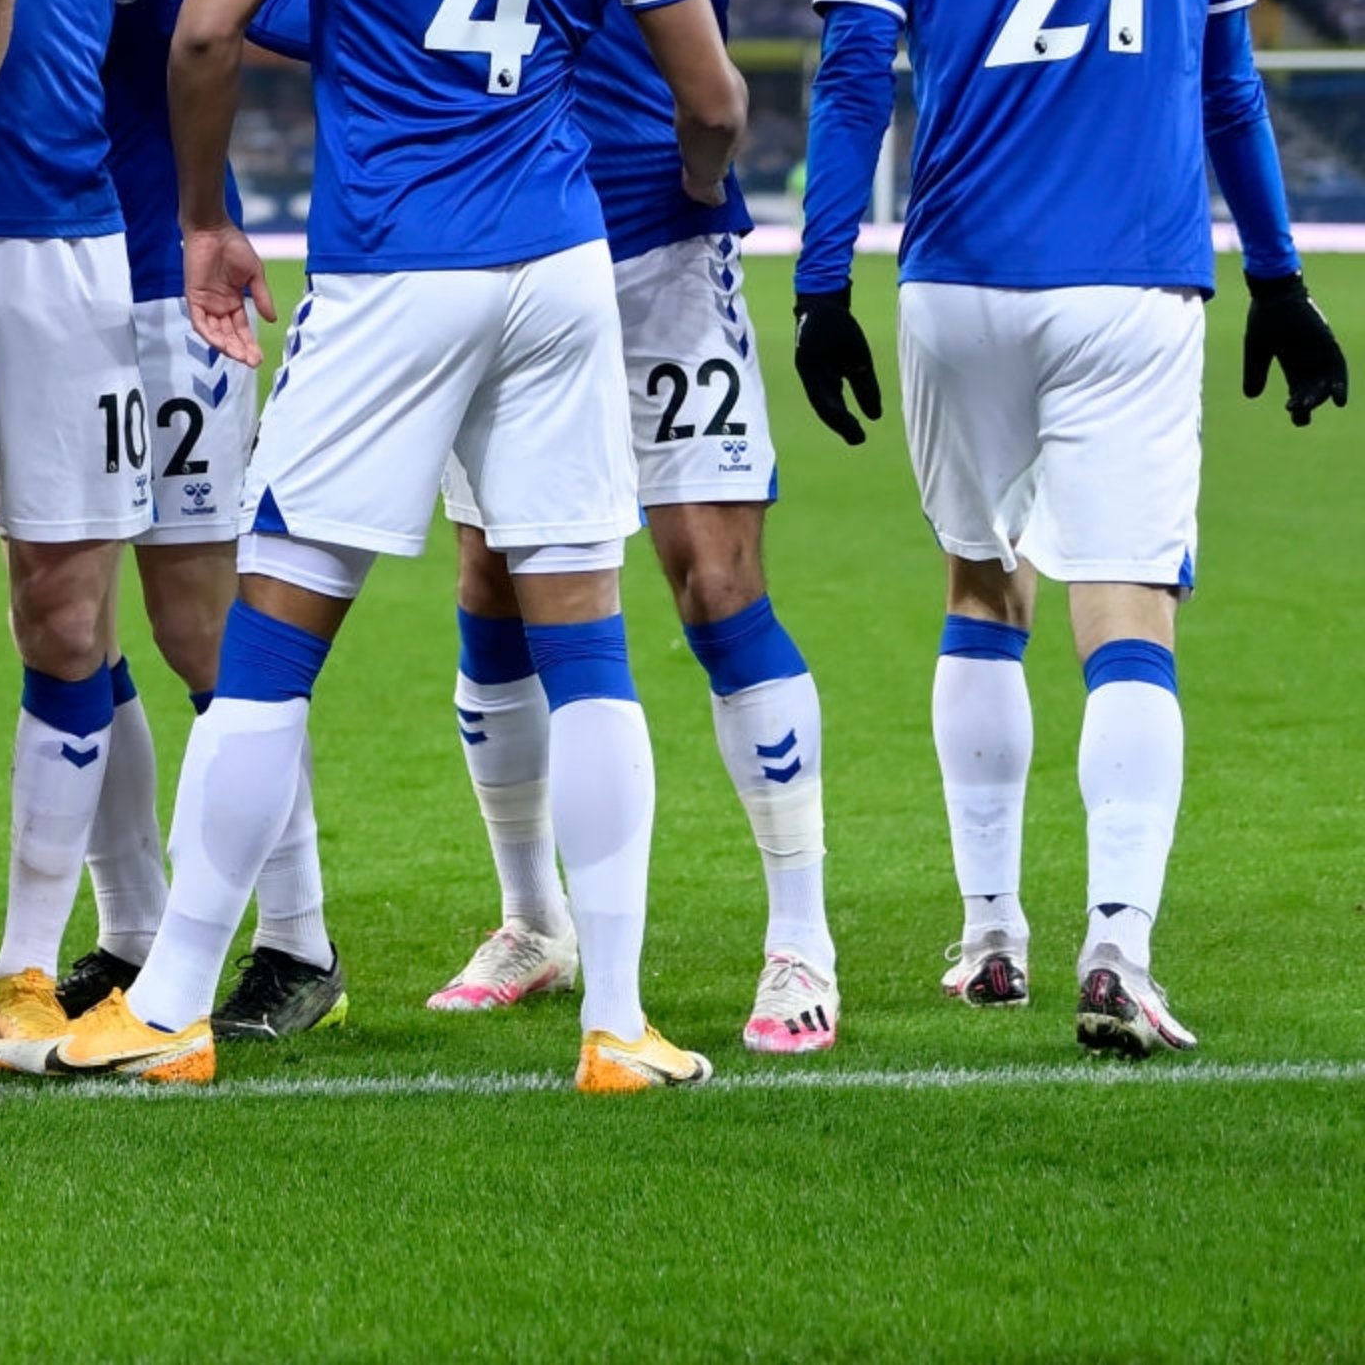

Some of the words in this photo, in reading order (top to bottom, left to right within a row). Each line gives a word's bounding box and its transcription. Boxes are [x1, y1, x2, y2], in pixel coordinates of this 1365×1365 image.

[98, 388, 147, 474] 10
[152, 397, 210, 478] 2
[646, 358, 748, 444] 22
